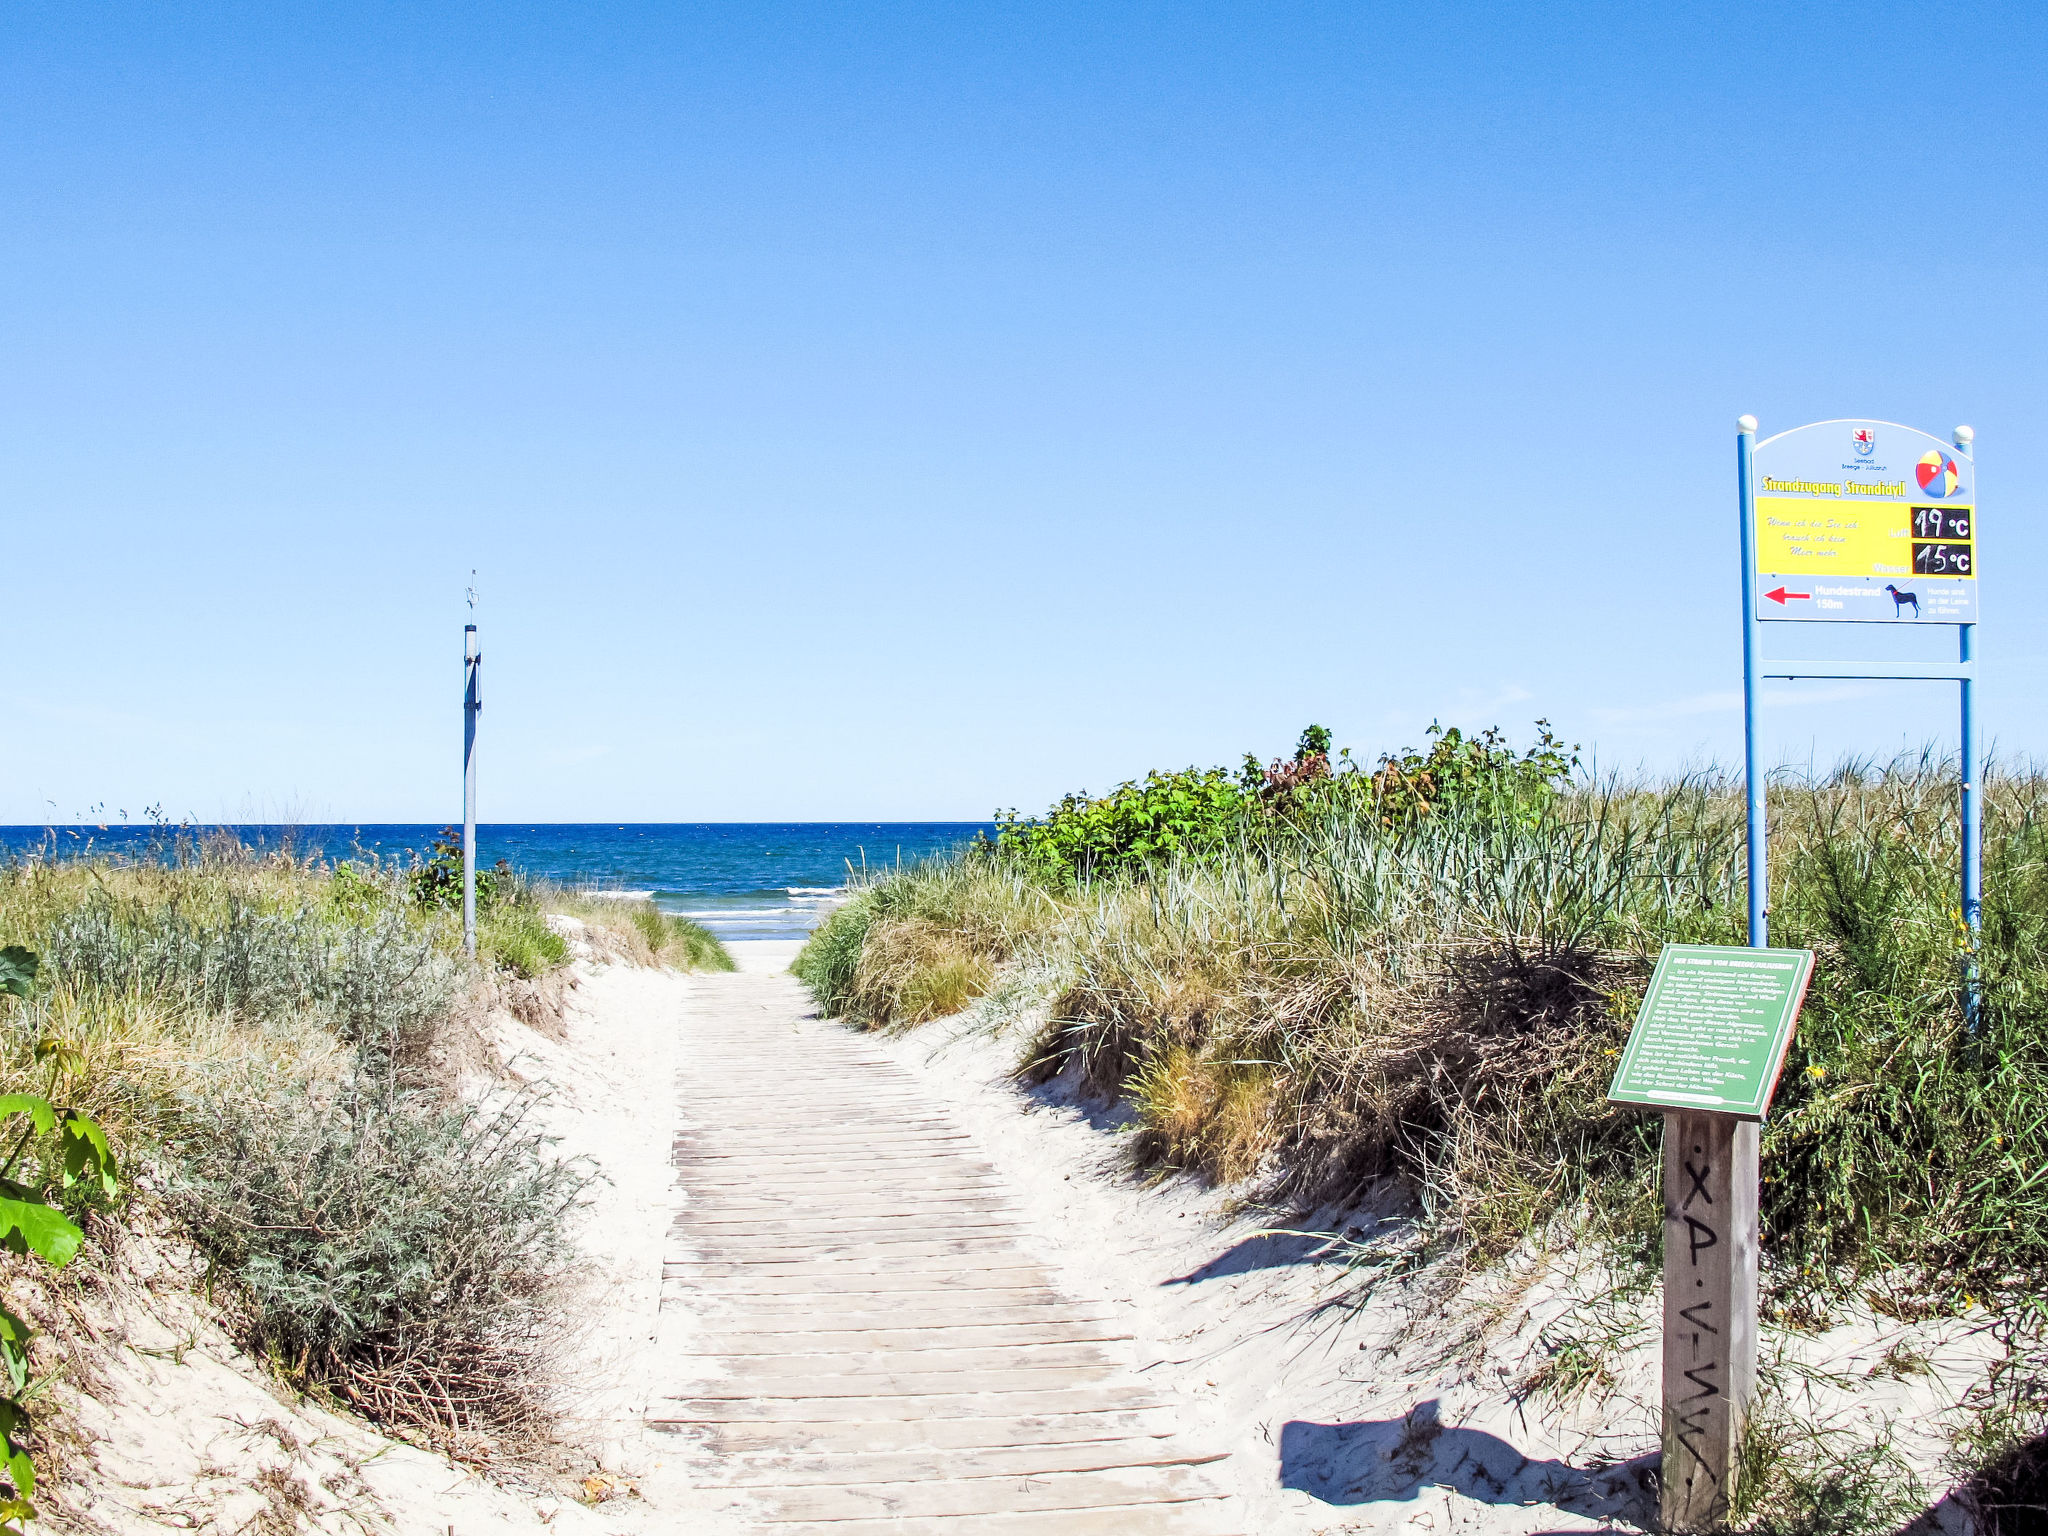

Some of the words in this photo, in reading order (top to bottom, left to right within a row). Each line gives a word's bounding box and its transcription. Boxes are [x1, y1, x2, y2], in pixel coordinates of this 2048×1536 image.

[1761, 477, 1842, 497] Strandzugang
[1845, 480, 1906, 498] Strandidyll
[1873, 564, 1909, 573] Wasser
[1916, 545, 1947, 574] 15
[1815, 585, 1881, 596] Hundestrand
[1816, 599, 1843, 609] 150m
